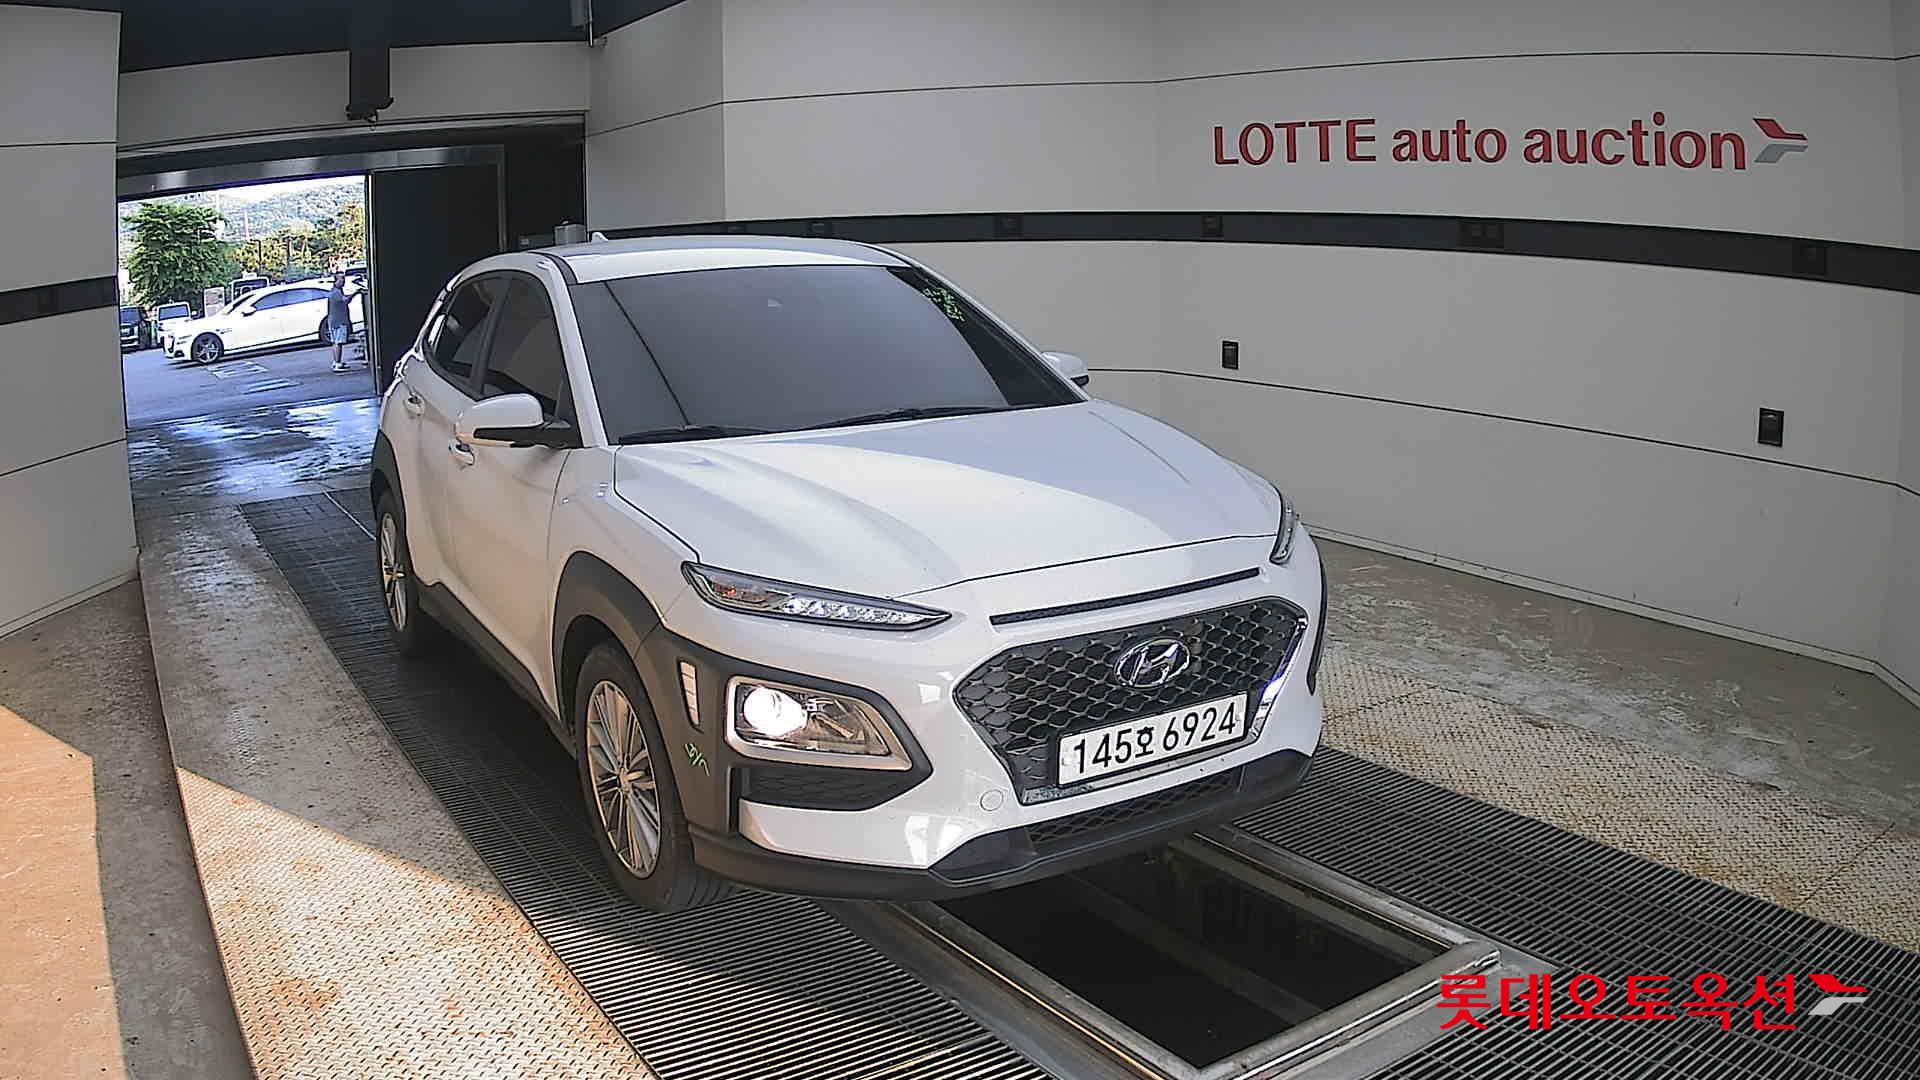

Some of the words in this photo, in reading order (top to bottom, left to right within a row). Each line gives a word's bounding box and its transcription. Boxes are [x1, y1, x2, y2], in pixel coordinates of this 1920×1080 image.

[1214, 118, 1377, 165] LOTTE
[1391, 118, 1507, 165] auto
[1523, 111, 1746, 170] auction
[1073, 726, 1154, 774] 145호
[1162, 702, 1236, 750] 6924
